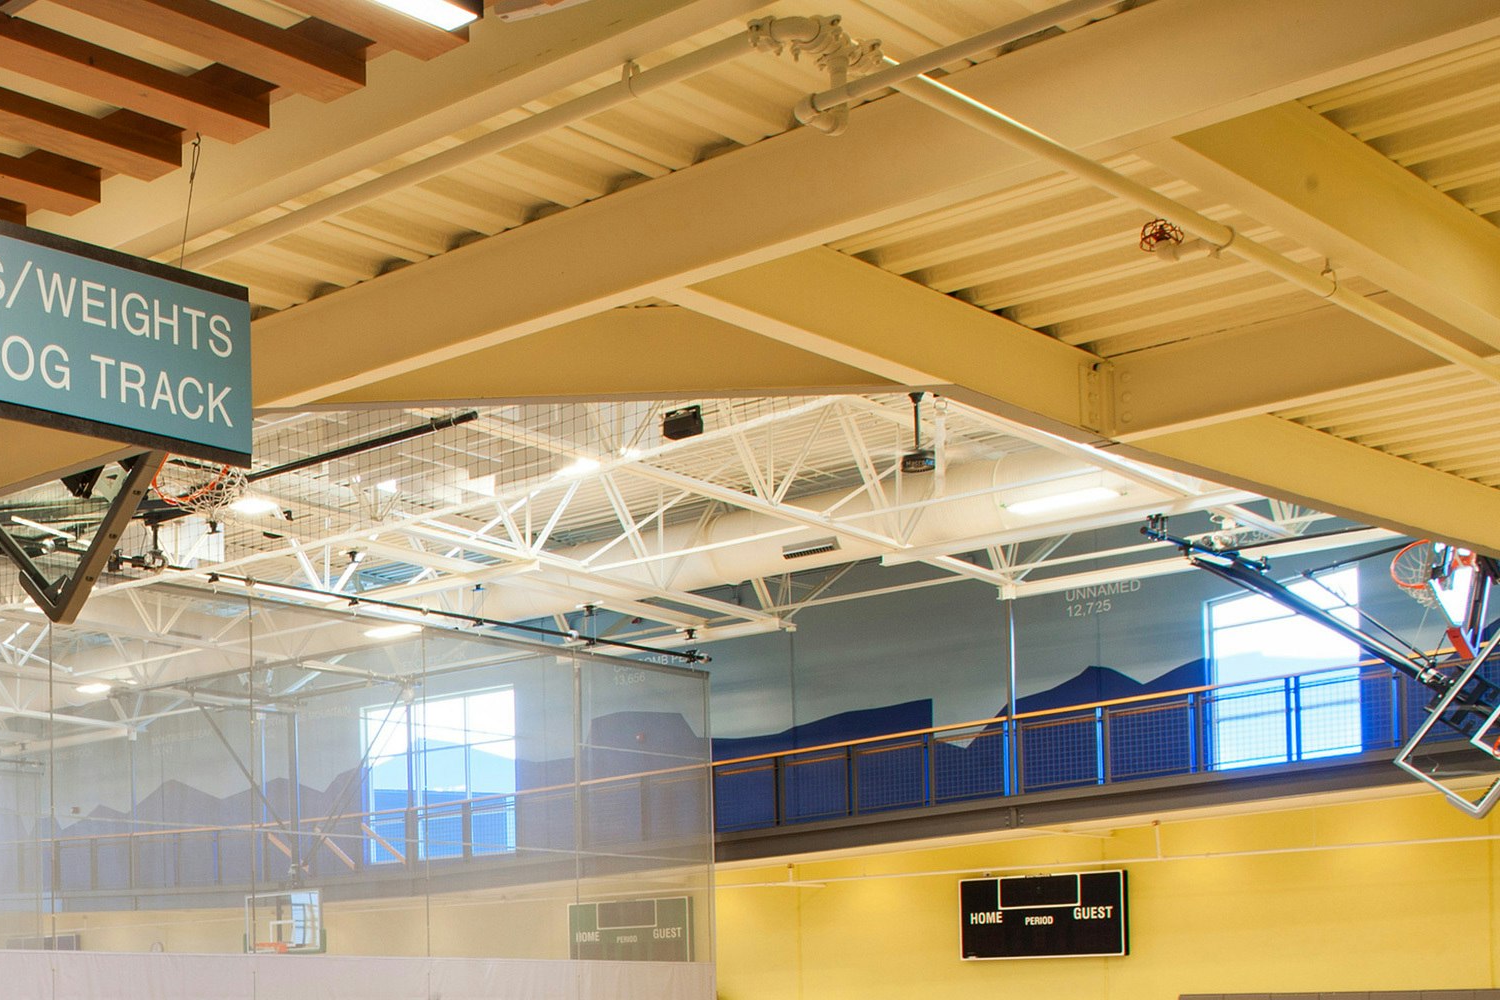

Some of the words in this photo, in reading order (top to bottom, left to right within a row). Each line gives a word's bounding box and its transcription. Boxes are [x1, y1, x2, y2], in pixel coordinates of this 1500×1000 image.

[90, 353, 233, 428] TRACK
[1065, 580, 1141, 601] UNNAMED
[1067, 599, 1112, 617] 12,725
[970, 911, 1003, 925] HOME
[1025, 916, 1054, 926] PERIOD
[1073, 906, 1113, 920] GUEST
[575, 931, 601, 943] HOME
[616, 935, 638, 944] PERIOD
[652, 927, 683, 939] GUEST
